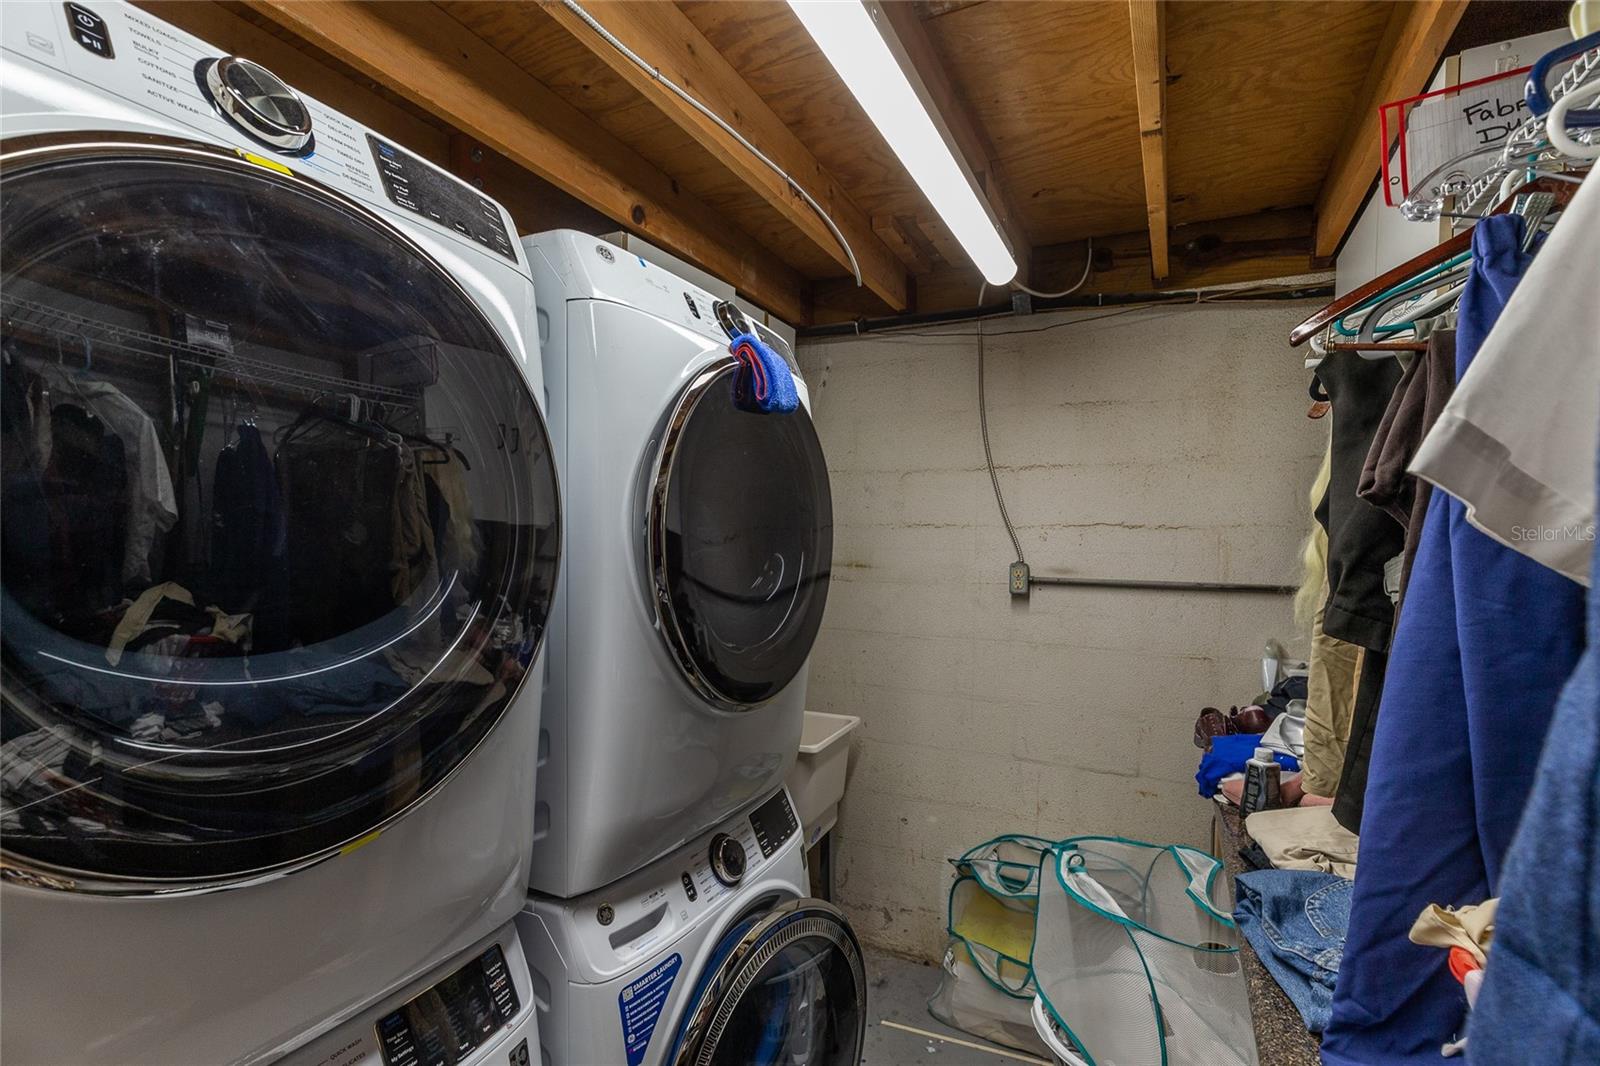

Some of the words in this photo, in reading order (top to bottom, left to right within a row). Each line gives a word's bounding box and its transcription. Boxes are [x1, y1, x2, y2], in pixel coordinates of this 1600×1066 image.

[128, 27, 162, 46] TOWELS
[137, 57, 177, 78] COTTONS
[141, 73, 178, 92] SANITIZE
[147, 89, 175, 105] ACTIVE
[176, 102, 199, 114] WEAR
[633, 971, 658, 991] SMARTER
[657, 956, 678, 975] LAUNDRY
[330, 1048, 346, 1060] QUICK
[347, 1038, 362, 1050] WASH
[397, 1045, 414, 1059] Settings
